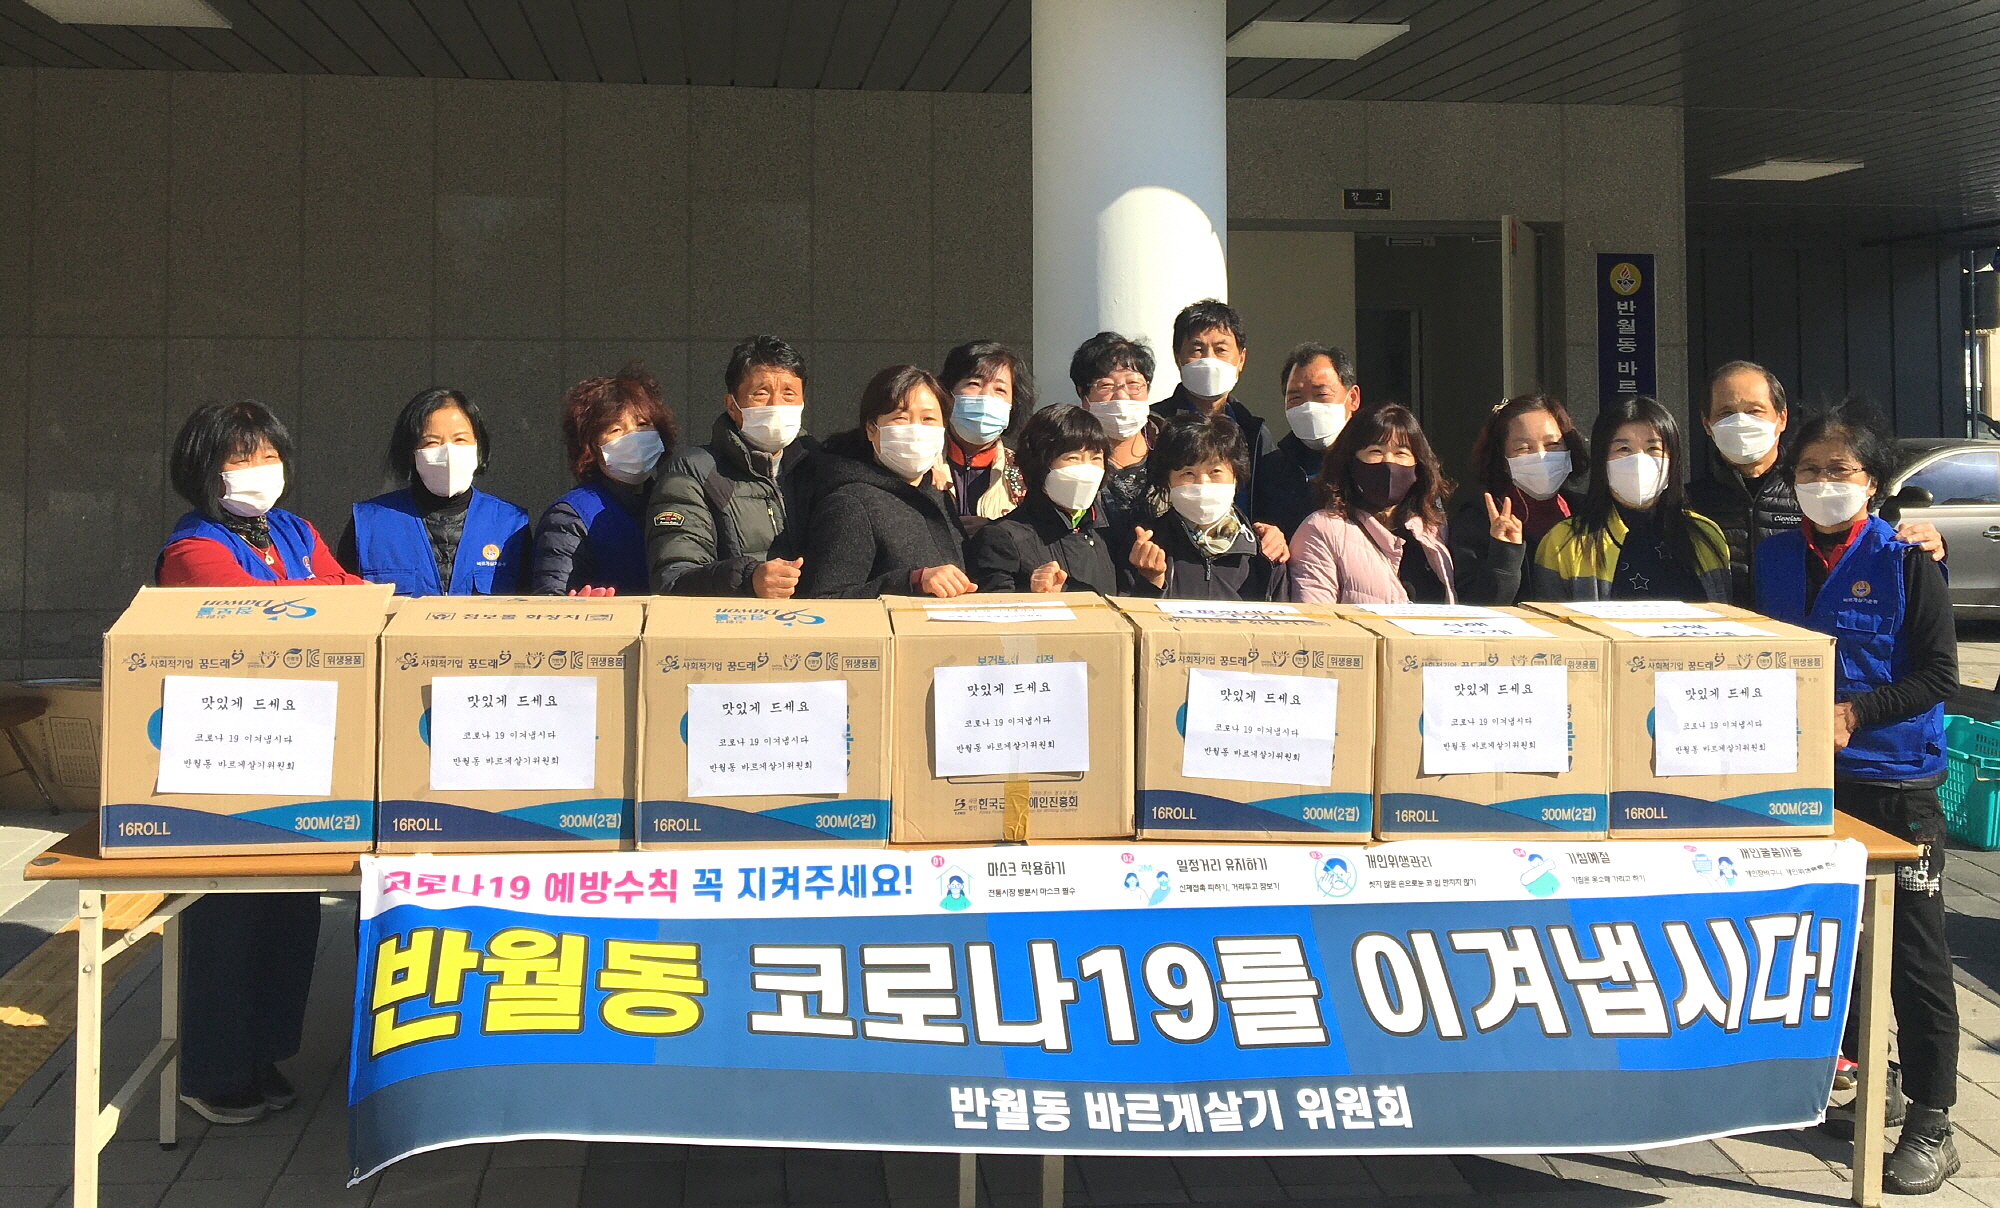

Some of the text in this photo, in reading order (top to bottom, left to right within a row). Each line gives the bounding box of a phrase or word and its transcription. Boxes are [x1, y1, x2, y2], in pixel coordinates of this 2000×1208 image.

[1616, 301, 1638, 393] 반월동 바르
[150, 659, 194, 669] 사회적기업
[199, 659, 230, 669] 꿈드래
[328, 656, 361, 665] 위생용품
[421, 659, 464, 668] 사회적기업
[468, 659, 498, 669] 꿈드래
[590, 657, 622, 666] 위생용품
[727, 661, 756, 671] 꿈드래
[845, 659, 877, 668] 위생용품
[1178, 655, 1216, 665] 사회적기업
[1220, 656, 1248, 666] 꿈드래
[1330, 657, 1360, 666] 위생용품
[1567, 660, 1596, 669] 위생용품
[1648, 662, 1683, 670] 사회적기업
[1688, 661, 1714, 670] 꿈드래
[1792, 658, 1821, 667] 위생용품
[682, 662, 722, 671] 사회적기업
[967, 681, 1051, 697] 맛있게 드세요
[1454, 683, 1533, 696] 맛있게 드세요
[1685, 686, 1763, 701] 맛있게 드세요
[467, 694, 558, 708] 맛있게 드세요
[1220, 688, 1301, 705] 맛있게 드세요
[202, 696, 296, 711] 맛있게 드세요
[722, 701, 810, 716] 맛있게 드세요
[964, 716, 1051, 728] 코로나 19 이겨냅시다
[1451, 717, 1532, 726] 코로나 19 이겨냅시다
[1683, 720, 1762, 730] 코로나 19 이겨냅시다
[463, 732, 556, 740] 코로나 19 이겨냅시다
[1215, 724, 1299, 737] 코로나 19 이겨냅시다
[194, 733, 292, 745] 코로나 19 이겨냅시다
[718, 736, 809, 747] 코로나 19 이겨냅시다
[956, 740, 1055, 753] 반월동 바르게살기위원회
[1443, 740, 1536, 751] 반월동 바르게살기위원회
[1675, 743, 1766, 754] 반월동 바르게살기위원회
[1204, 747, 1300, 762] 반월동 바르게살기위원회
[184, 759, 295, 770] 반월동 바르게살기위원회
[453, 756, 559, 766] 반월동 바르게살기위원회
[710, 760, 812, 773] 반월동 바르게살기위원회
[1152, 806, 1197, 820] 16ROLL
[1303, 806, 1360, 822] 300M(2겹)
[1541, 807, 1596, 822] 300M(2겹)
[1624, 807, 1667, 820] 16ROLL
[1768, 801, 1822, 816] 300M(2겹)
[294, 814, 360, 831] 300M(2겹)
[560, 813, 622, 829] 300M(2겹)
[815, 814, 876, 829] 300M(2겹)
[1395, 810, 1439, 823] 16ROLL
[118, 822, 171, 836] 16ROLL
[392, 818, 442, 831] 16ROLL
[653, 818, 702, 832] 16ROLL
[1365, 855, 1432, 868] 개인위생관리
[1565, 852, 1611, 864] 기침예절
[988, 861, 1066, 876] 마스크 착용하기
[1176, 857, 1268, 872] 일정거리 유지하기
[382, 863, 912, 904] 코로나19 예방수칙 꼭 지켜주세요!
[1384, 880, 1396, 888] 않은
[1443, 879, 1462, 887] 만지지
[1464, 878, 1476, 887] 않기
[1572, 876, 1590, 884] 기침은
[988, 889, 1016, 897] 전통시장
[1040, 888, 1060, 896] 마스크
[1062, 887, 1076, 895] 필수
[1232, 883, 1258, 891] 거리두고
[1260, 882, 1280, 890] 장보기
[370, 912, 1841, 1059] 반월동 코로나19를 이겨냅시다!
[950, 1084, 1414, 1134] 반월동 바르게살기 위원회
